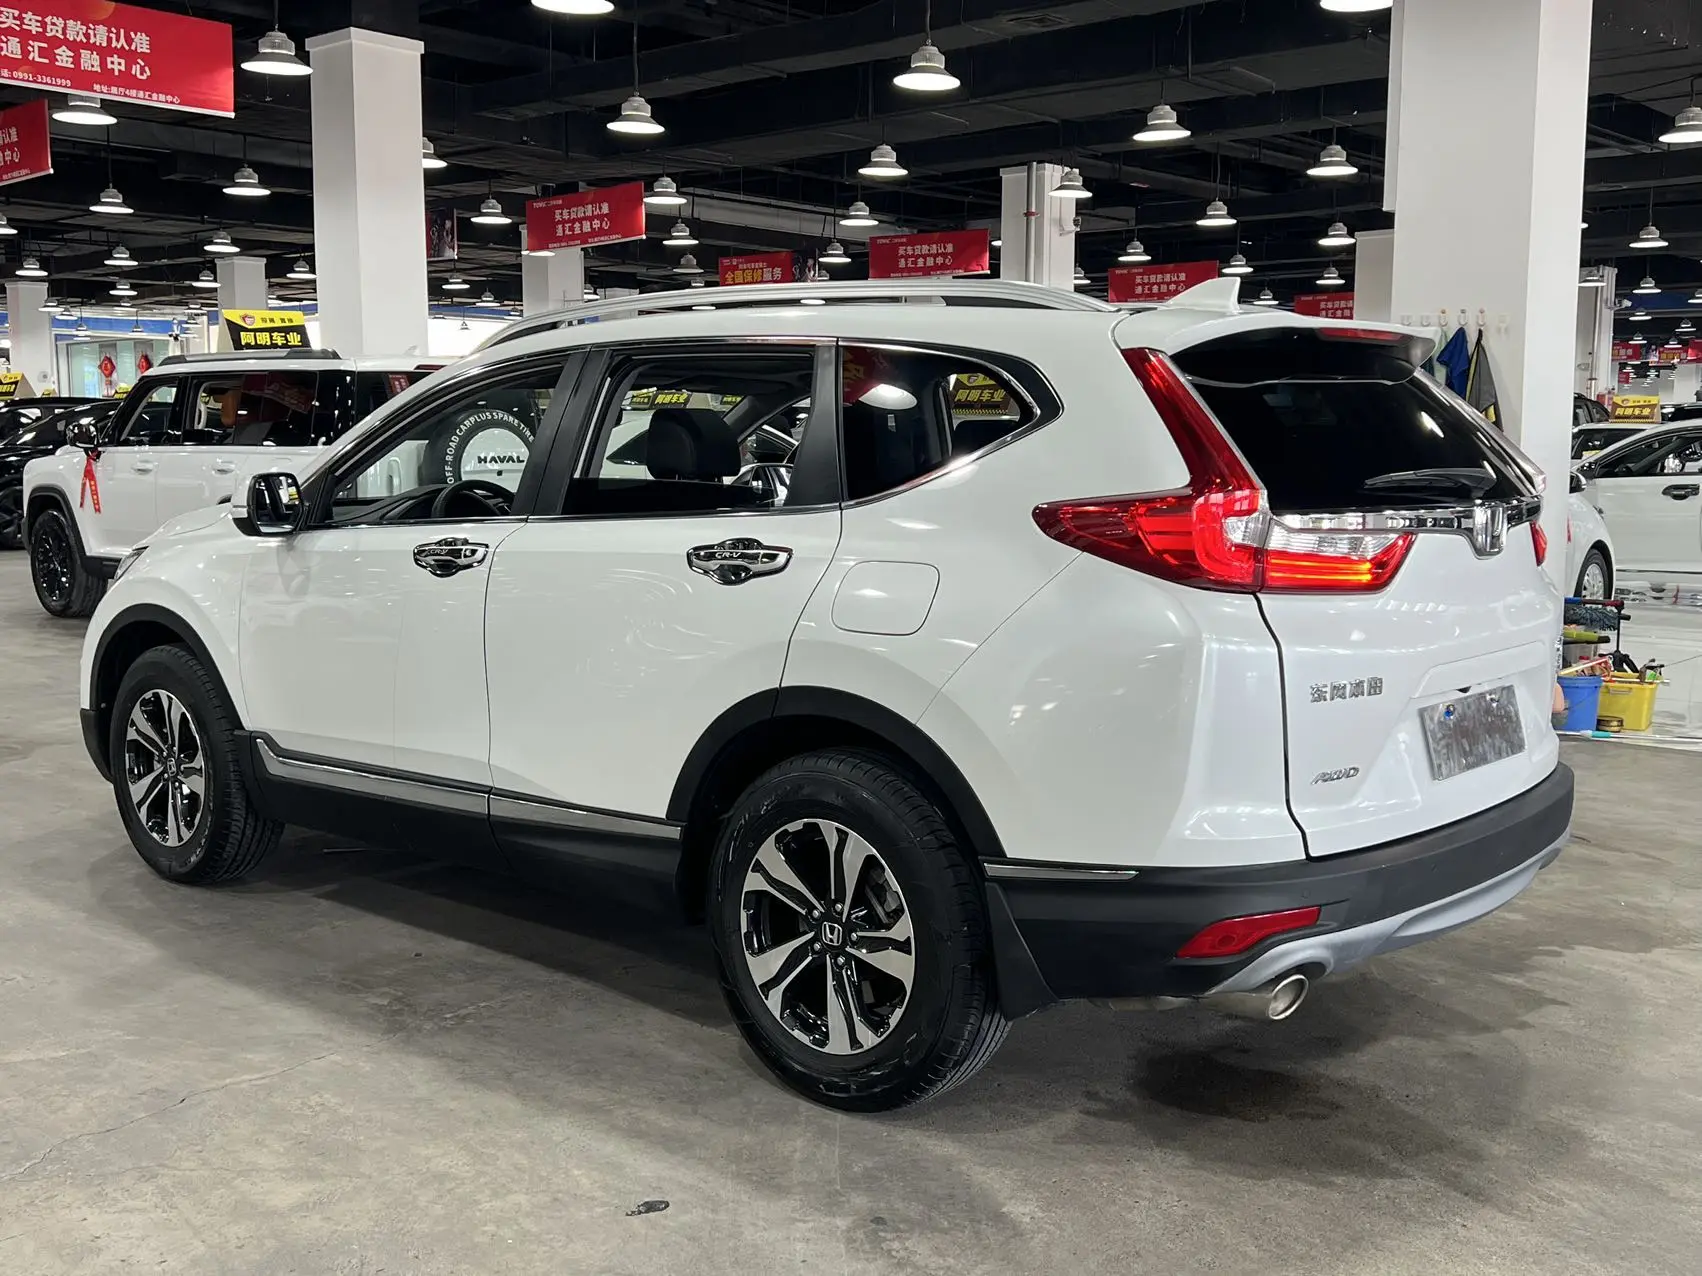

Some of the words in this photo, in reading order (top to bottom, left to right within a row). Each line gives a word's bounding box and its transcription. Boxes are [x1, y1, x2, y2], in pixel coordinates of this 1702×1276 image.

[0, 6, 151, 54] 买车贷款请认准
[1, 35, 151, 80] 通汇金融中心
[12, 71, 72, 87] 0991-3361999
[554, 202, 610, 221] 买车贷款请认准
[556, 217, 610, 237] 通汇金融中心
[897, 243, 954, 256] 买车贷款请认准
[898, 256, 954, 268] 通汇金融中心
[725, 267, 782, 284] 全国保修服务
[240, 331, 302, 346] 阿明车业
[955, 389, 1006, 402] 阿明车业
[444, 435, 460, 484] OFF-ROAD
[456, 411, 492, 436] CARPLUS
[492, 411, 519, 427] SPARE
[519, 422, 535, 443] TIRE
[477, 455, 525, 464] HAVAL
[715, 551, 742, 559] CR-V
[1310, 676, 1384, 703] 东风本田
